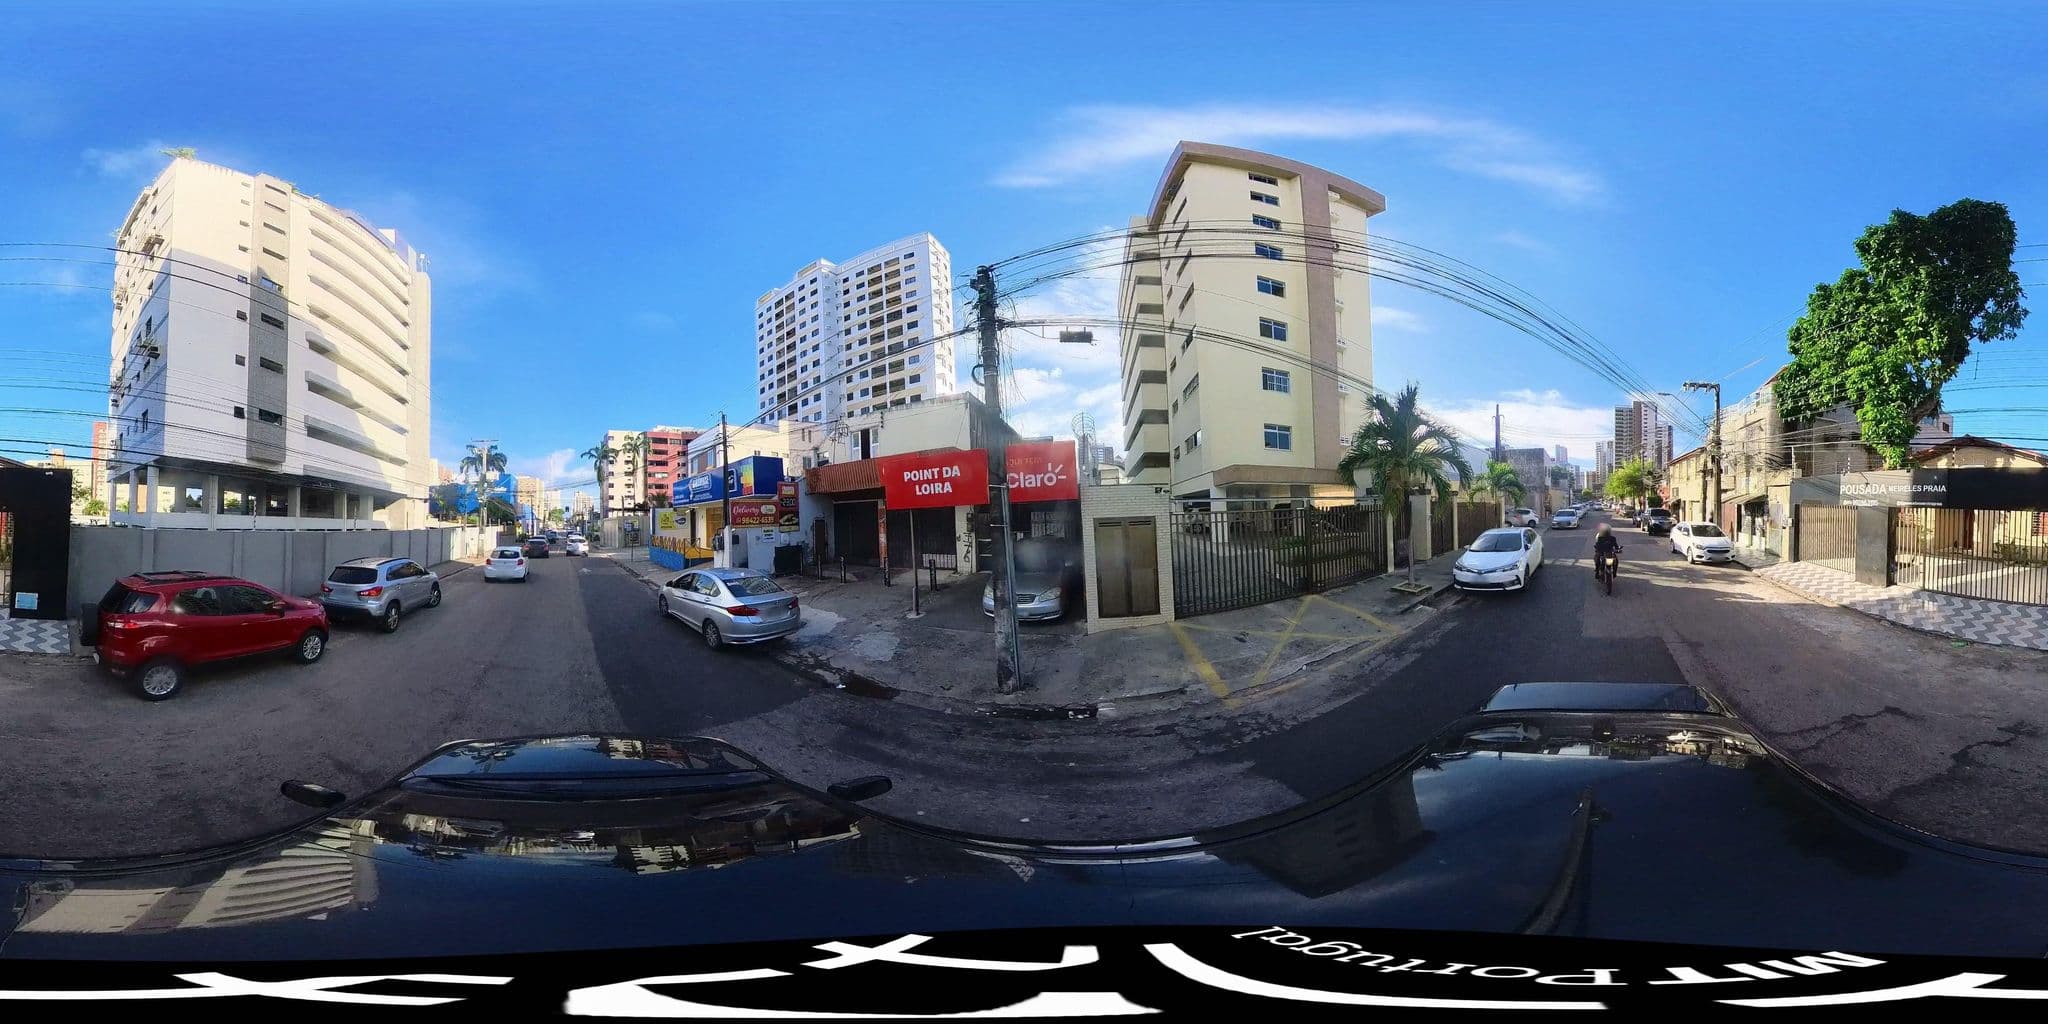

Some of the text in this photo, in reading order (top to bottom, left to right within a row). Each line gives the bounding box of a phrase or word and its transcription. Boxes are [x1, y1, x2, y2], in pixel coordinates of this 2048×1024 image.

[904, 465, 961, 482] POINT DA
[1007, 470, 1058, 489] Claro
[915, 482, 953, 495] LOIRA
[1840, 483, 1887, 495] POUSADA
